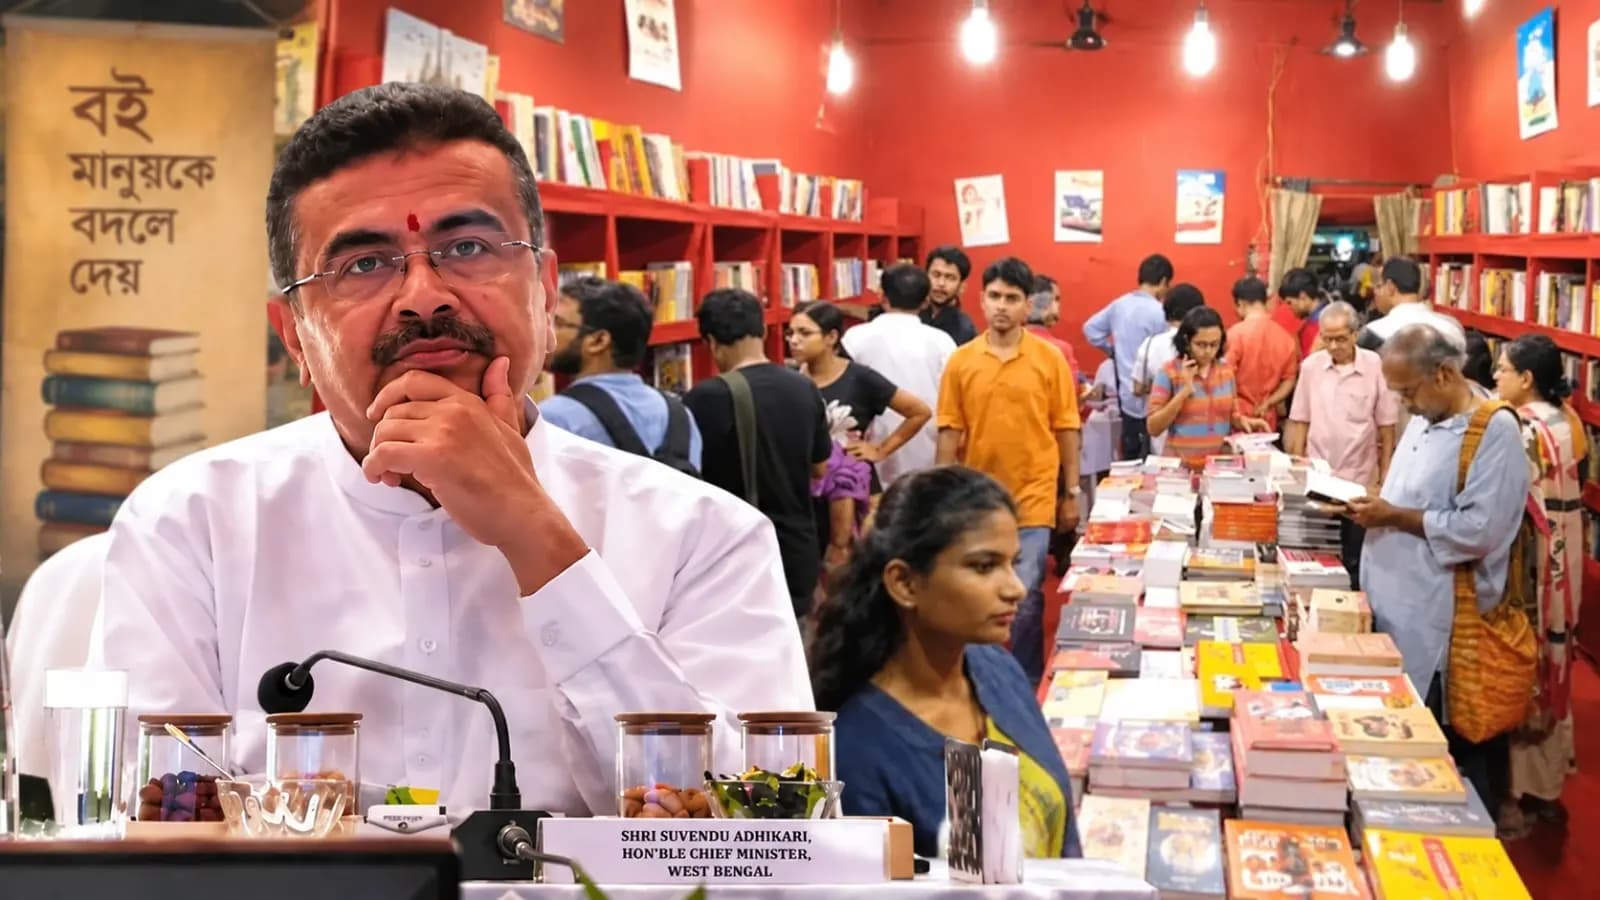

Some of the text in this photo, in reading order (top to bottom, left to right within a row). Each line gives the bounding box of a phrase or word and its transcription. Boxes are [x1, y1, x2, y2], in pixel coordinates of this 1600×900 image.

[68, 66, 154, 143] বই
[69, 207, 178, 245] বদলে
[68, 258, 142, 296] দেয়
[621, 830, 811, 844] SHRI SUVENDU ADHIKARI,
[689, 847, 733, 860] CHIEF
[736, 847, 811, 862] MINISTER,
[667, 865, 772, 878] WEST BENGAL
